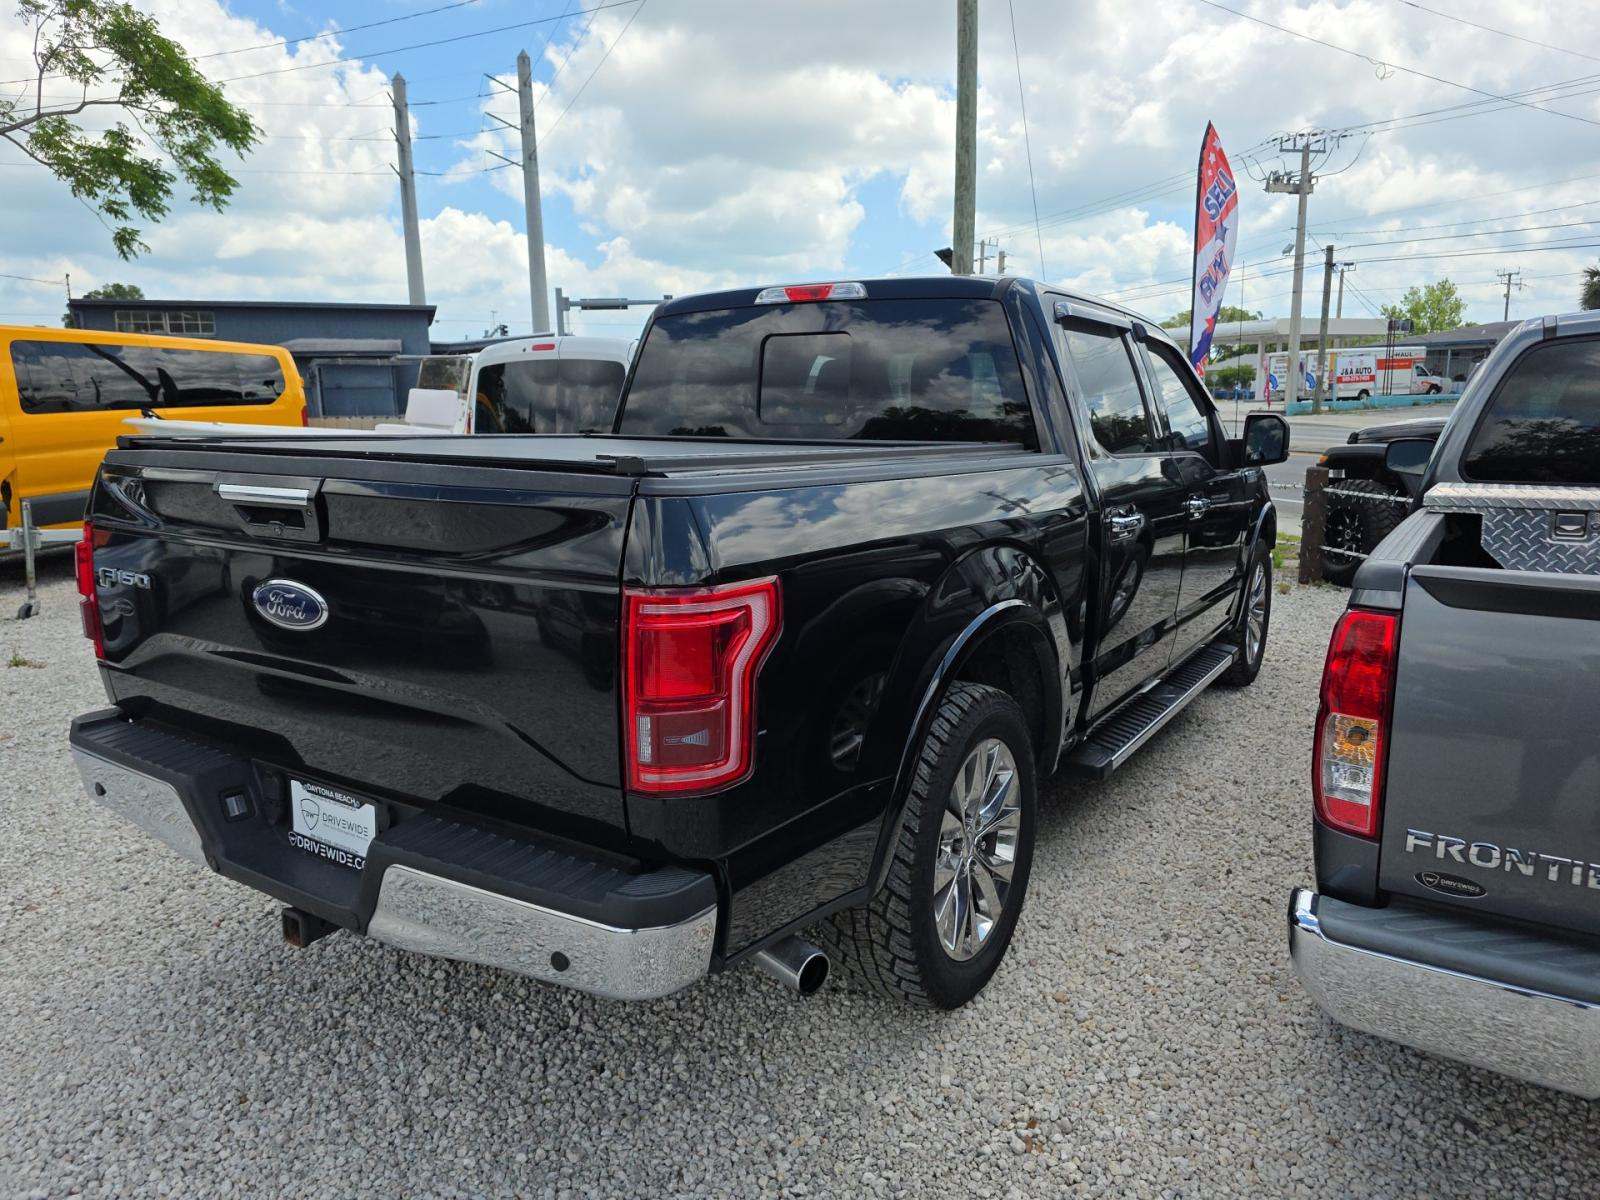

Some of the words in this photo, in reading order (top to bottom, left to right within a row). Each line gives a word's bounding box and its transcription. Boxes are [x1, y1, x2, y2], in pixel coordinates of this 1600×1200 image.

[1355, 367, 1372, 375] AUTO
[266, 589, 306, 620] Ford
[306, 783, 334, 798] DAYTONA
[334, 791, 355, 804] BEACH
[322, 812, 369, 837] DRIVEWIDE
